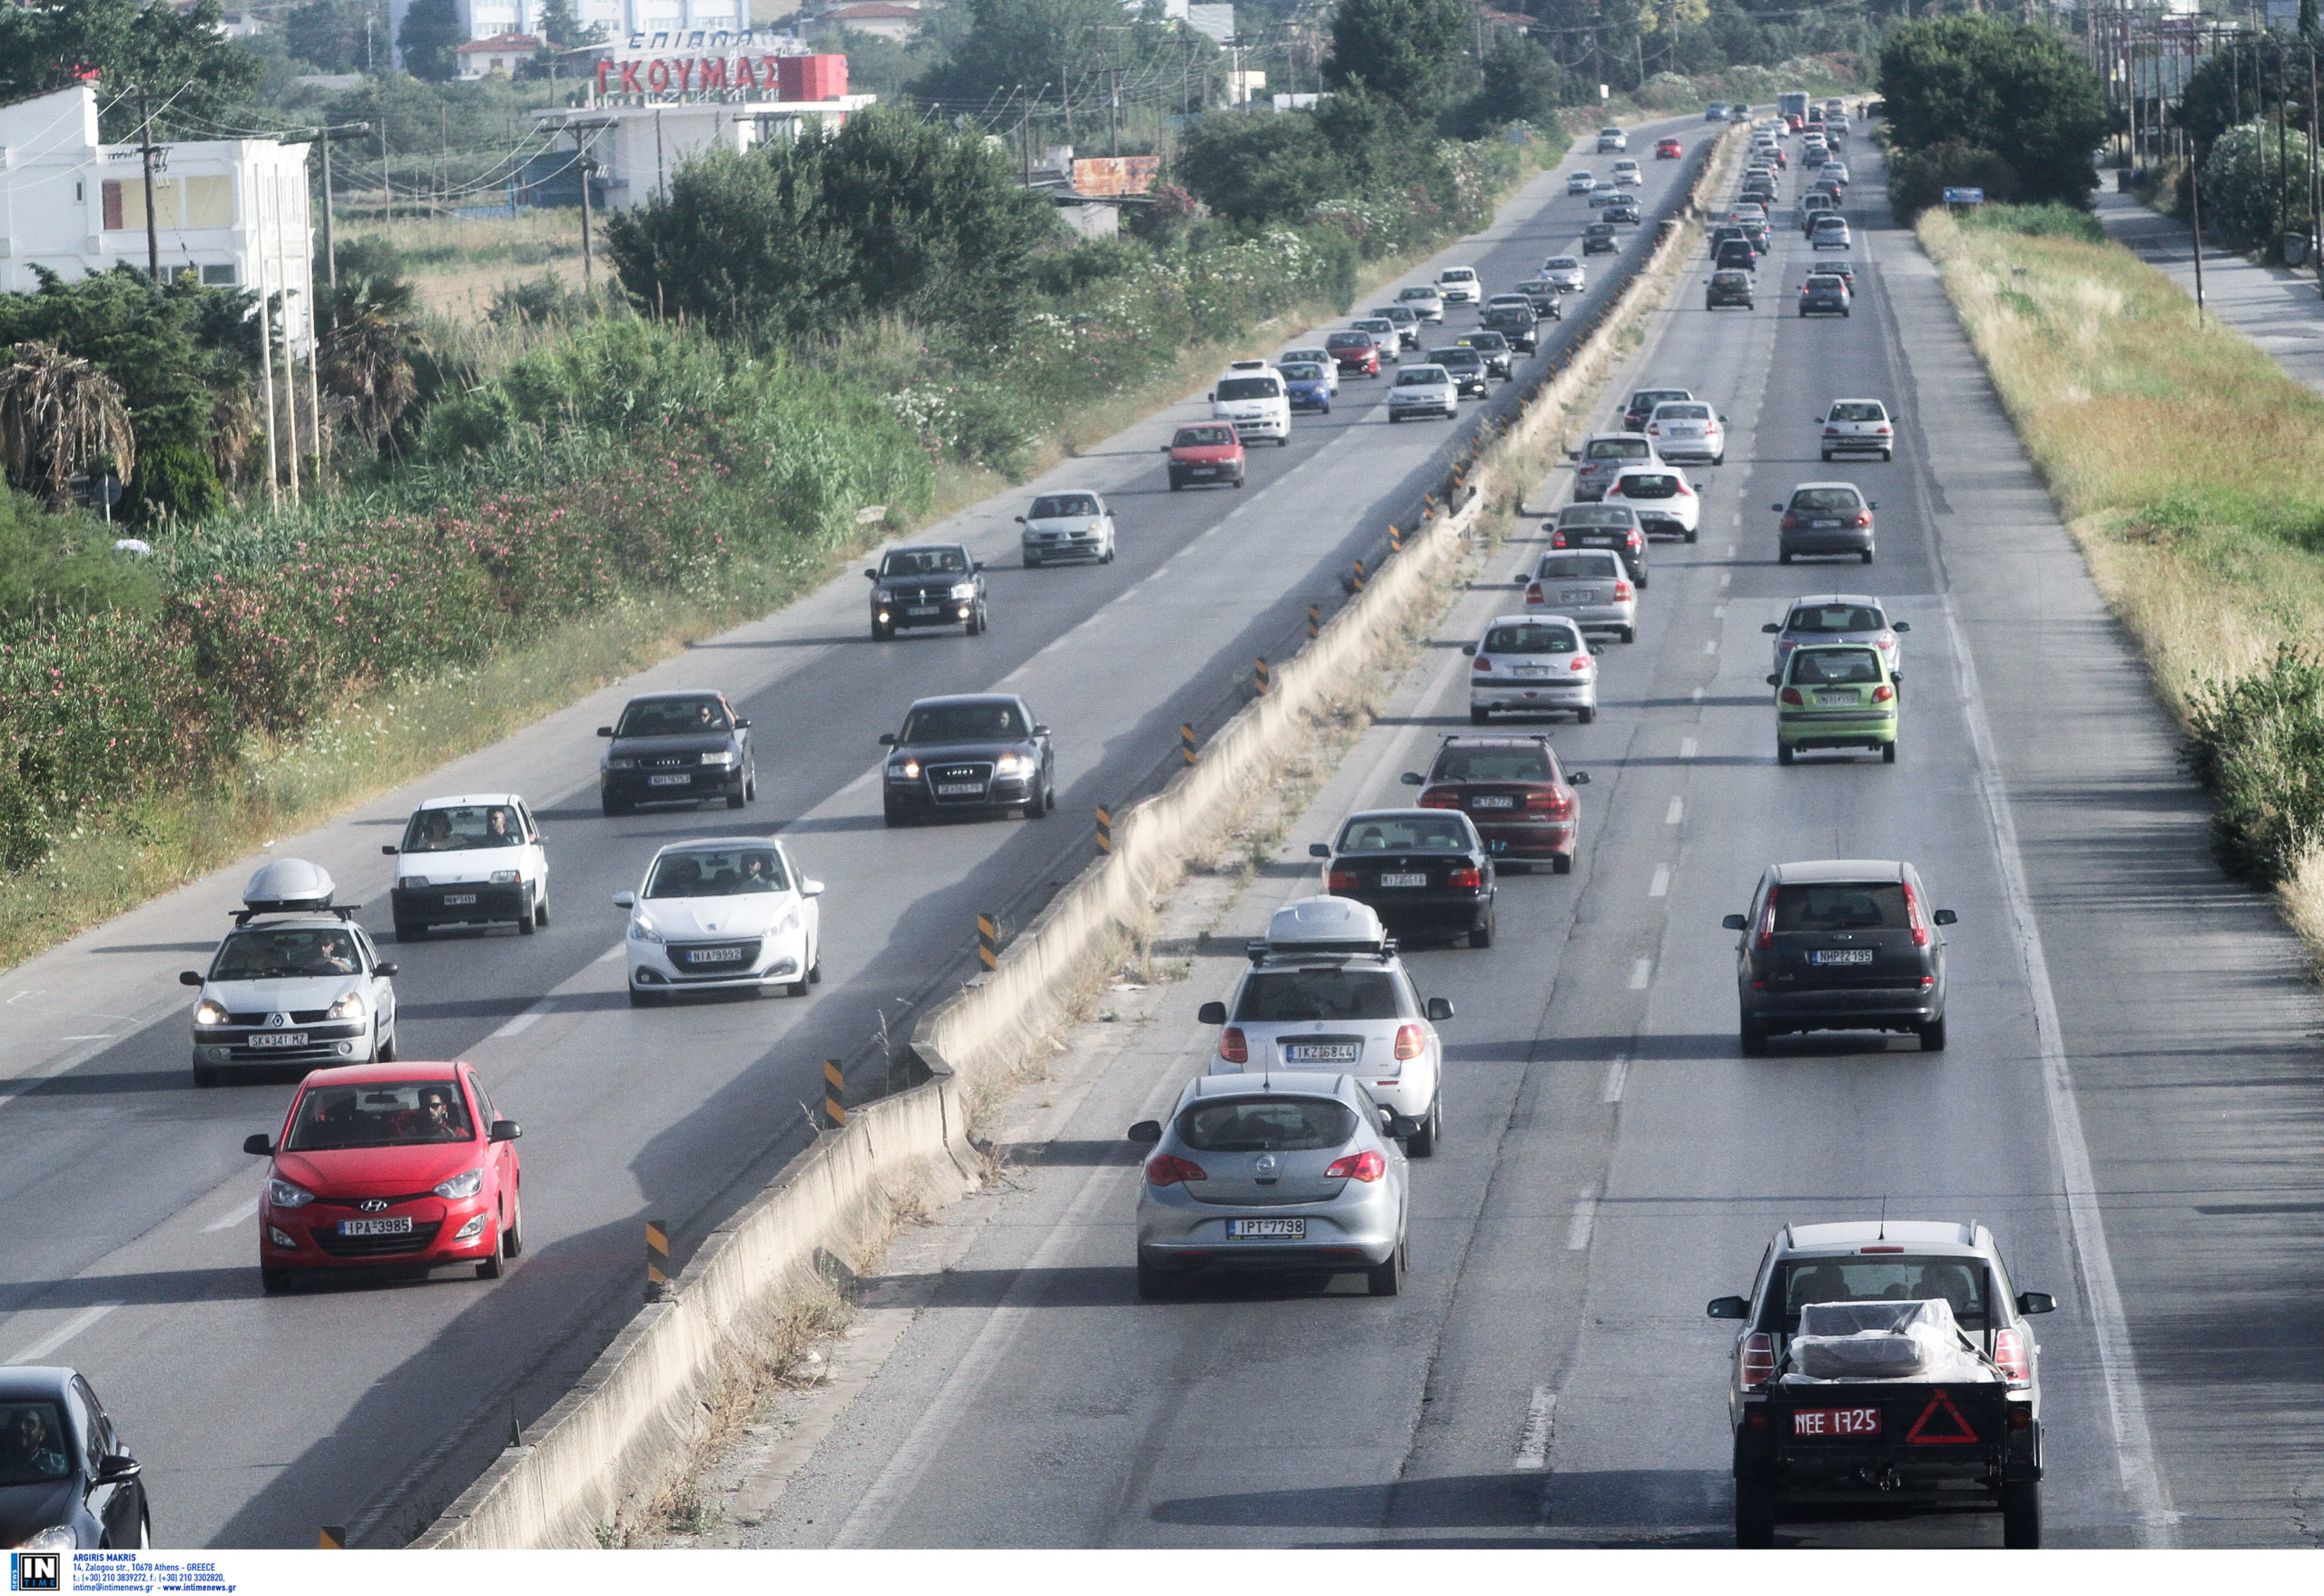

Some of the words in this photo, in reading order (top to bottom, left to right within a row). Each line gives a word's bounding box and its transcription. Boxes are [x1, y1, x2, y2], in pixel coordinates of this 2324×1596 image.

[597, 56, 781, 94] ΓΚΟΥΜΑΣ
[252, 1036, 264, 1047] SK
[271, 1035, 288, 1046] 341
[1795, 1413, 1825, 1433] NEE
[1835, 1409, 1876, 1433] 1725
